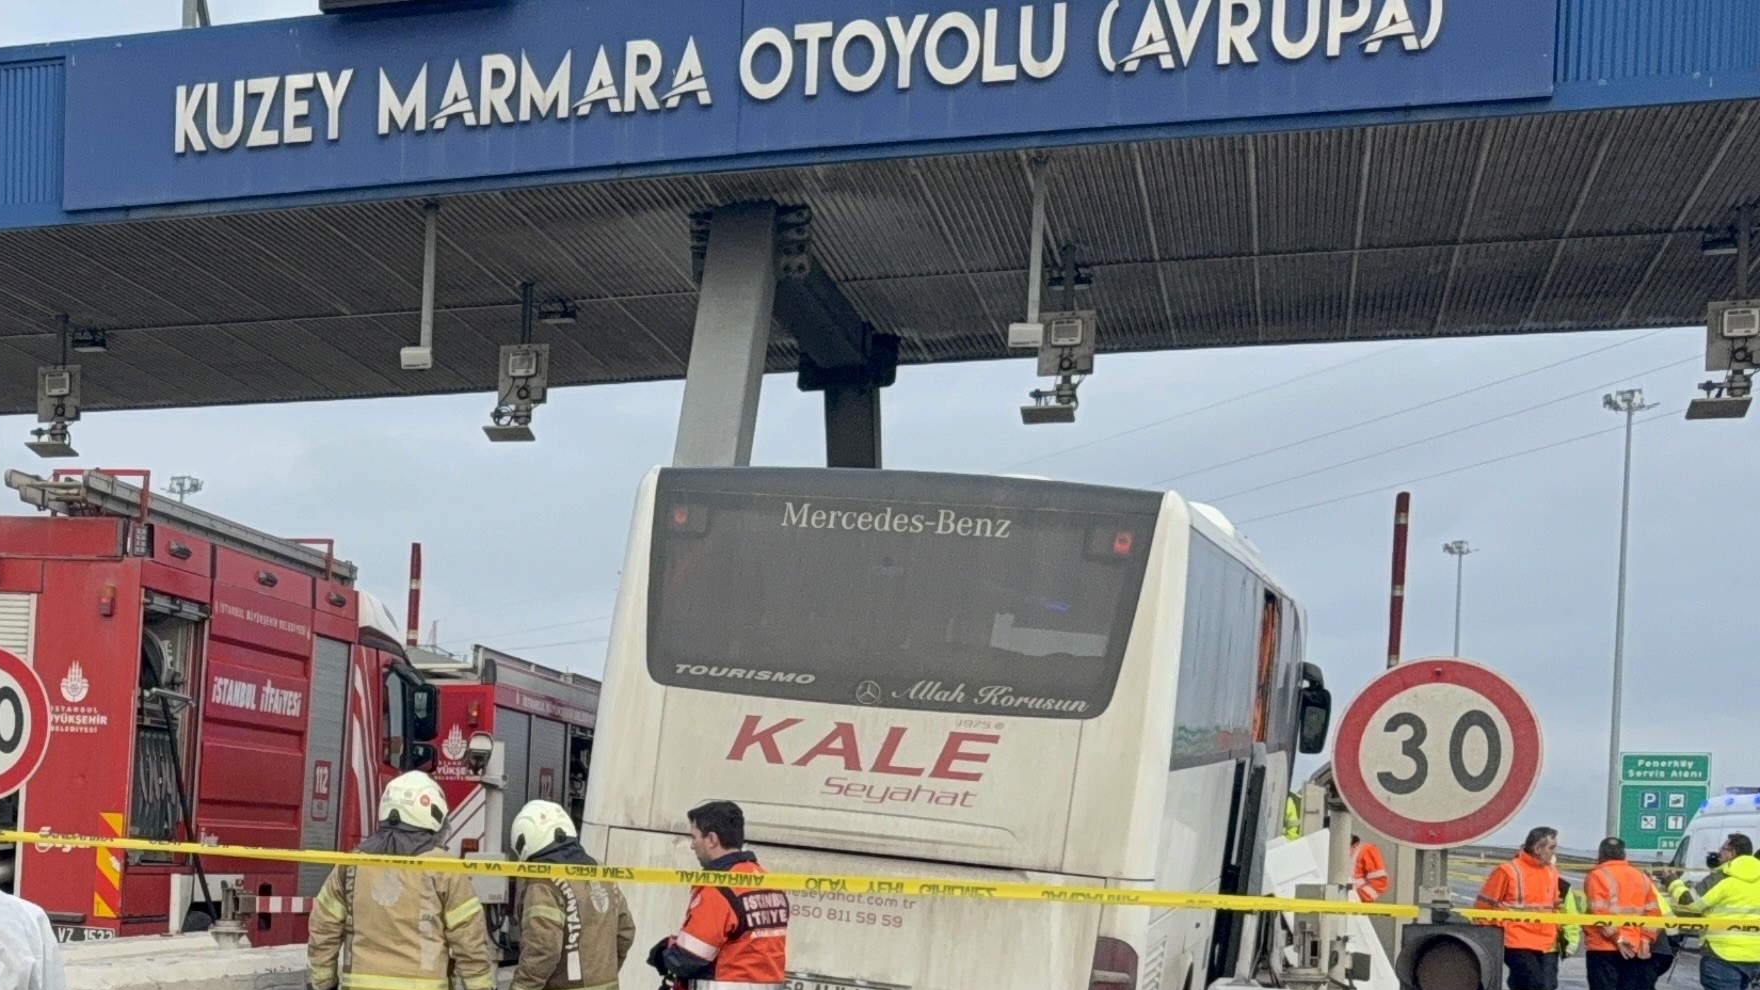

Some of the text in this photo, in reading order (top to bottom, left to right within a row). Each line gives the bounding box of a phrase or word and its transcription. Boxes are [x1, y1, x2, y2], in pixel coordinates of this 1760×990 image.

[175, 0, 1443, 154] KUZEY MARMARA OTOYOLU (AVRUPA)
[781, 501, 1011, 540] Mercedes-Benz
[674, 663, 816, 685] TOURISMO
[891, 680, 1091, 713] Allah Korusun
[725, 715, 1002, 783] KALE
[1376, 709, 1502, 796] 30
[819, 776, 978, 808] Seyahat
[1643, 793, 1657, 808] P
[826, 908, 851, 923] 811
[855, 911, 877, 925] 59
[881, 914, 903, 928] 59
